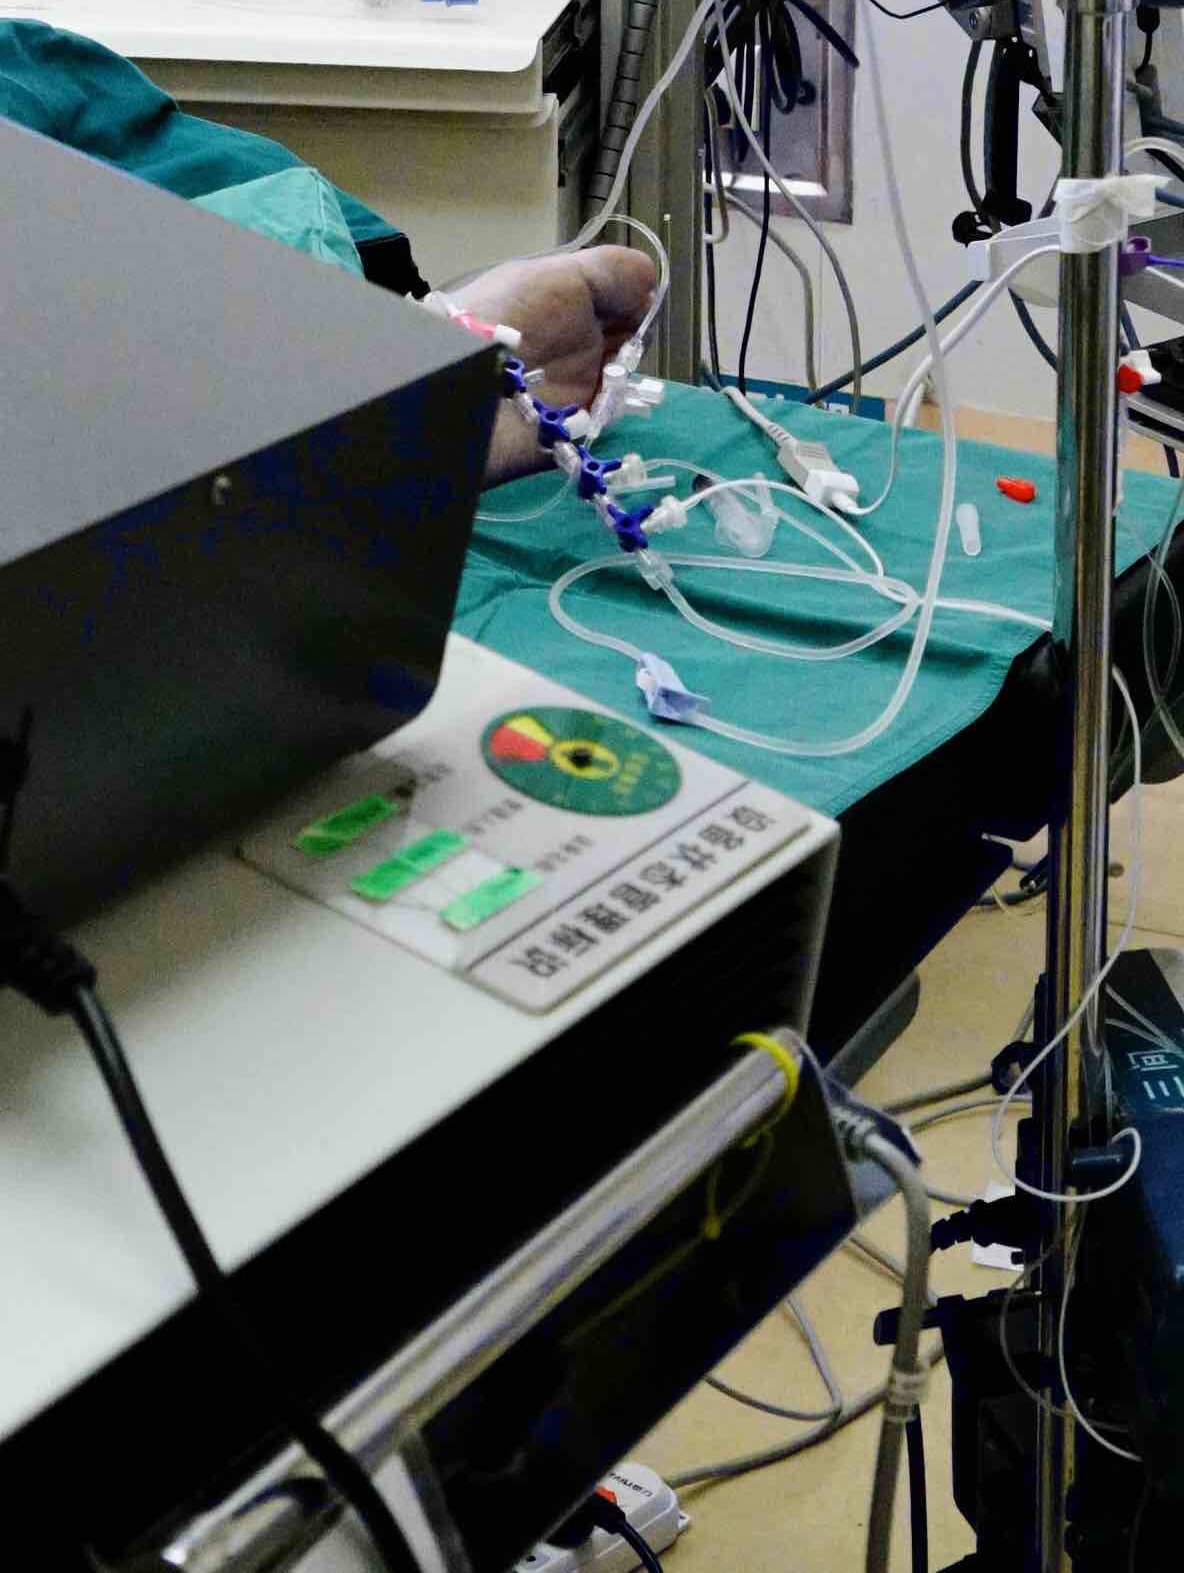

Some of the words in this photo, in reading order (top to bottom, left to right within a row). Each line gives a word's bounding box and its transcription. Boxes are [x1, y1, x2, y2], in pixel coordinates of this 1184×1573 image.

[506, 805, 778, 979] 设备状态管理标识
